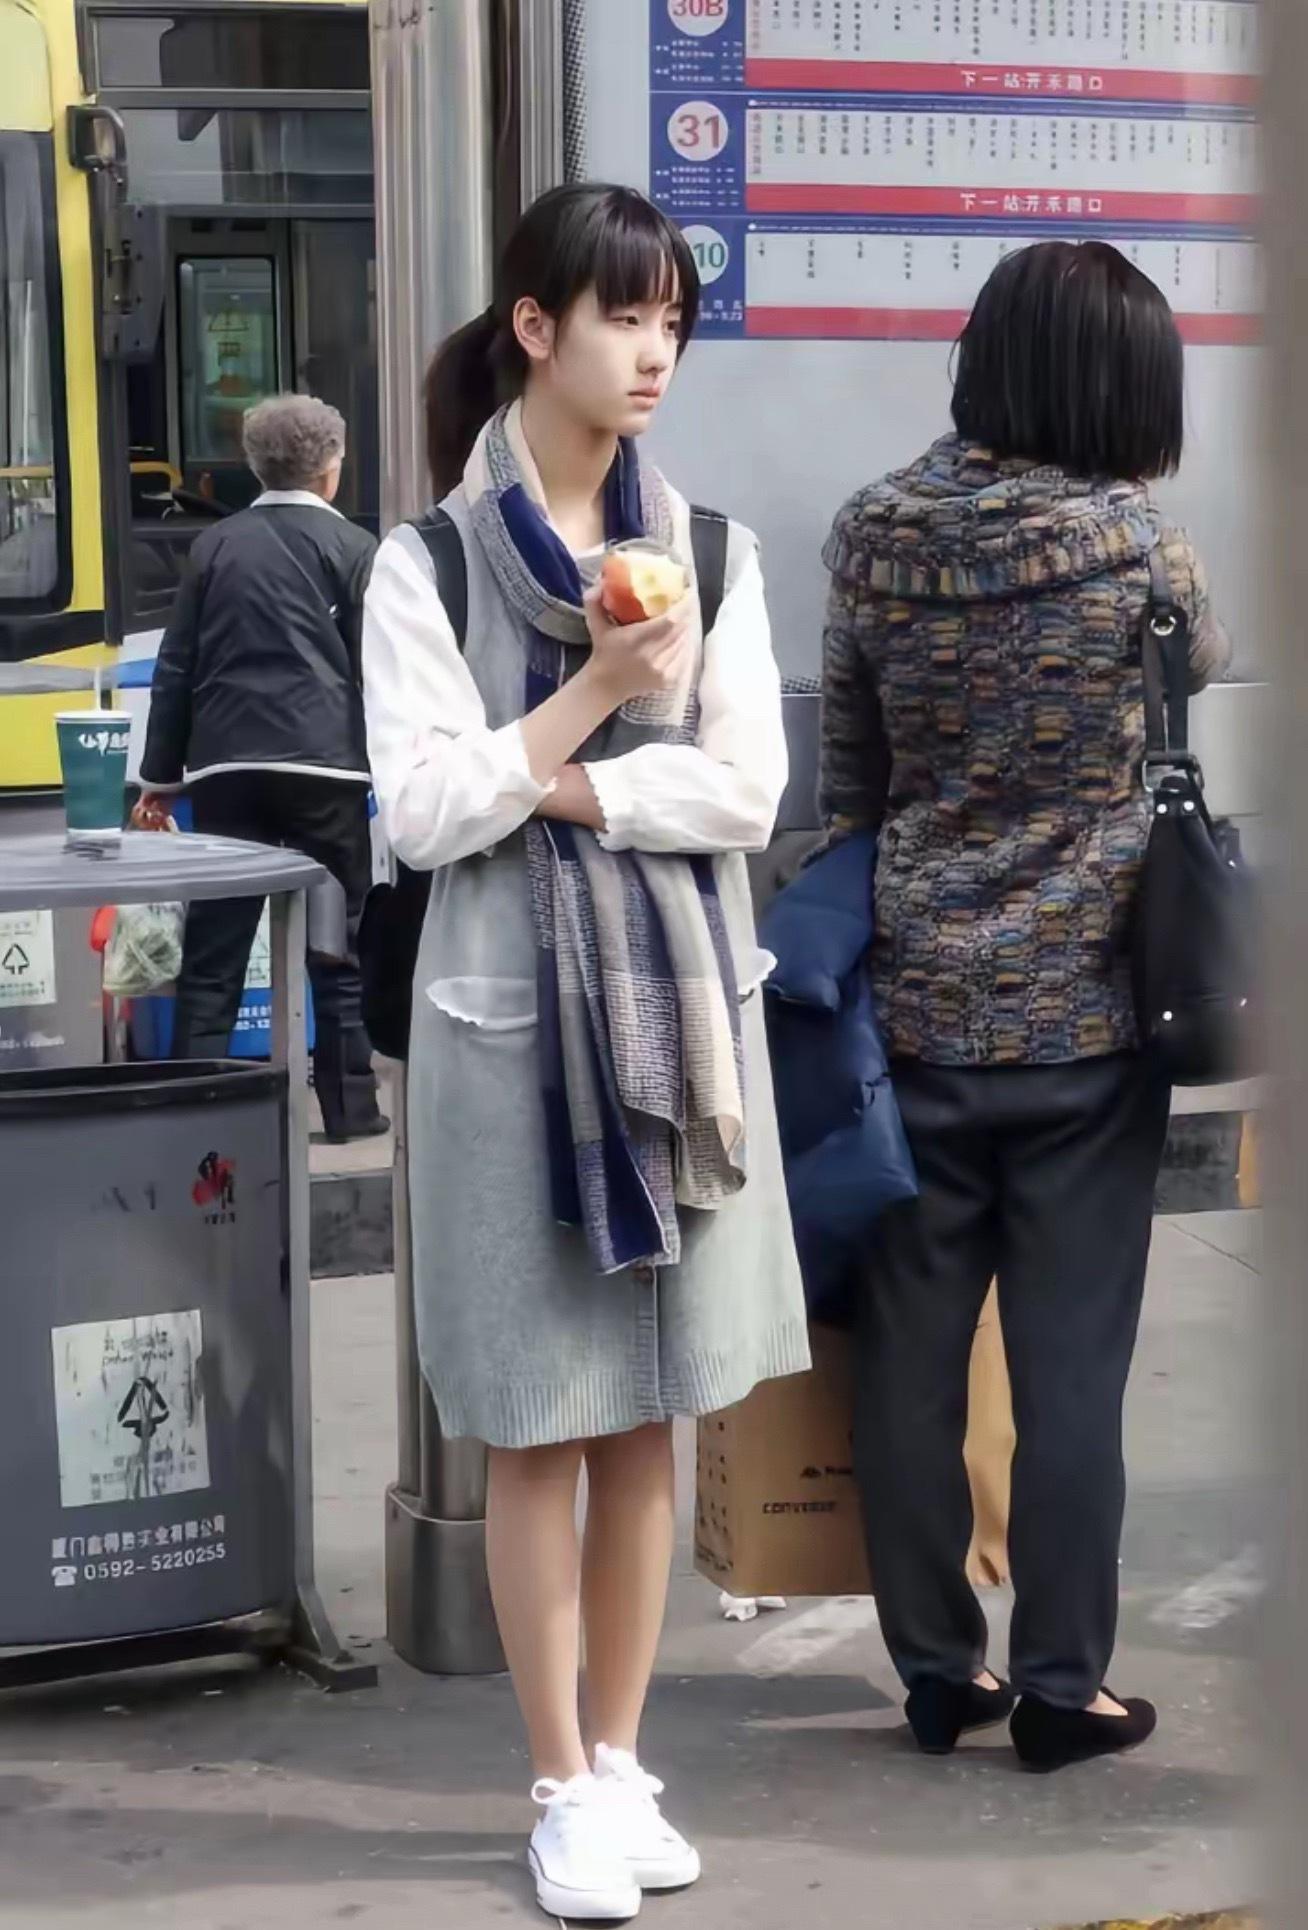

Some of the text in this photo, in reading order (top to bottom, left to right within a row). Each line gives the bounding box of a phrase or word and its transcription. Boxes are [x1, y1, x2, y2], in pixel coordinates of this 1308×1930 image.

[672, 0, 724, 17] 30B
[676, 114, 720, 148] 31
[692, 241, 725, 268] 10
[83, 1542, 226, 1580] 0592-5220255
